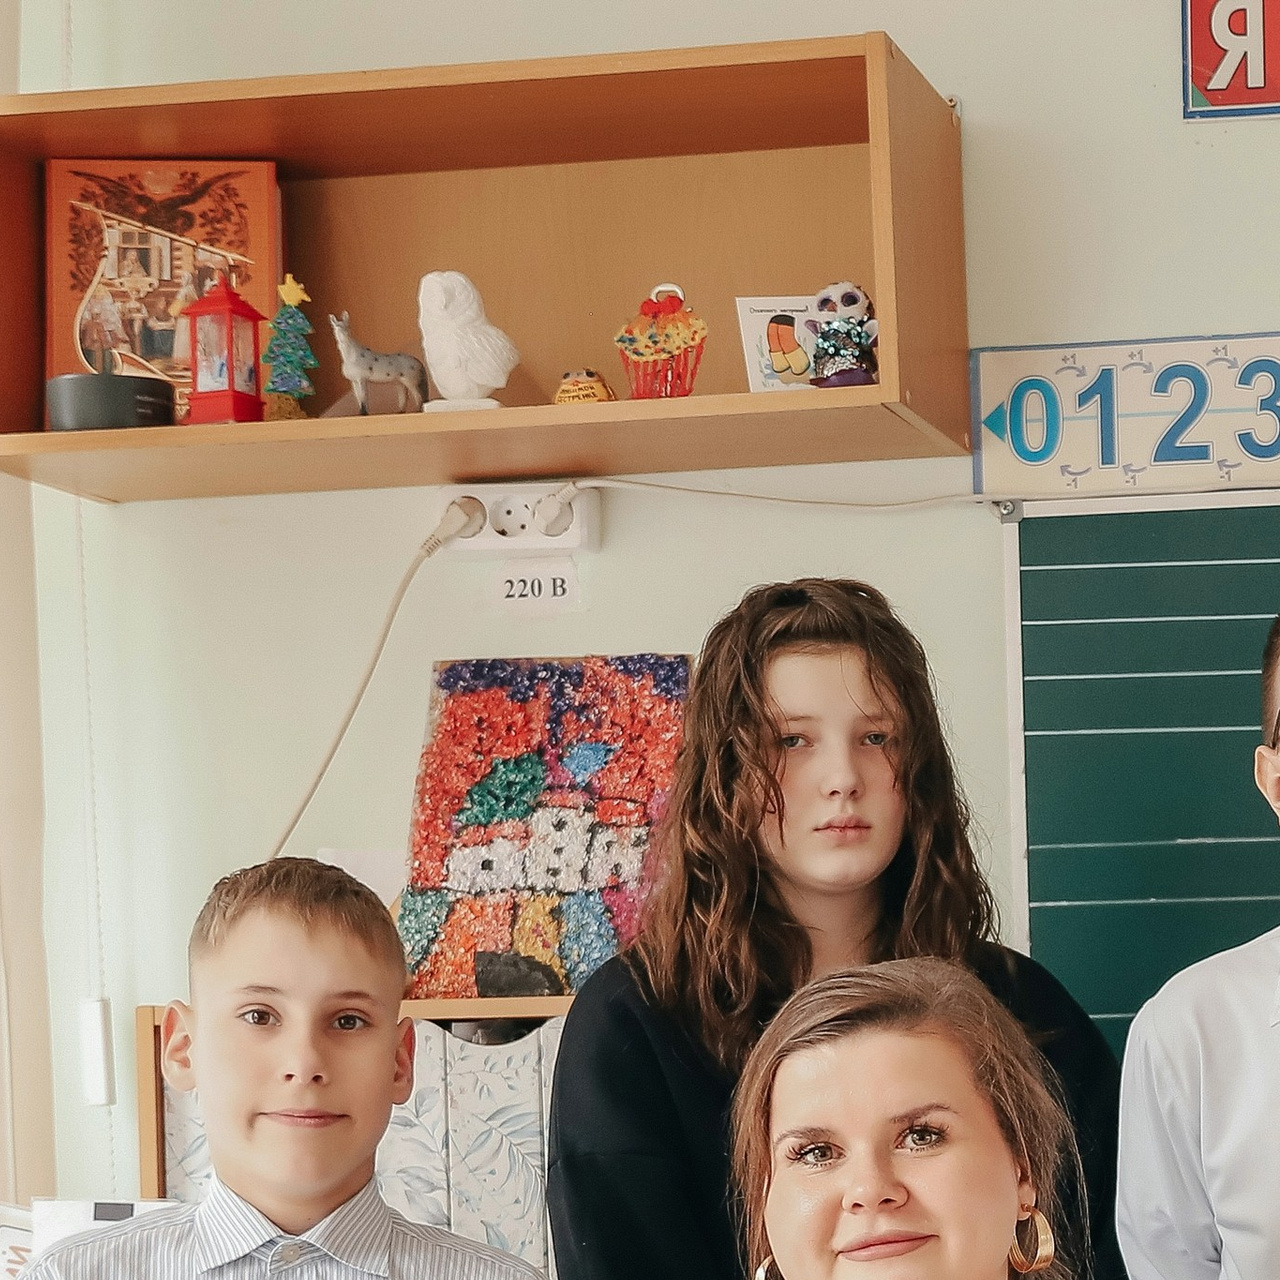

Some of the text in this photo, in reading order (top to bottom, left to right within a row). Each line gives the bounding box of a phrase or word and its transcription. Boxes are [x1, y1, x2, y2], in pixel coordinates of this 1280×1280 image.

[1206, 0, 1264, 90] Я
[1061, 353, 1077, 365] +1
[1129, 350, 1144, 362] +1
[1212, 345, 1229, 357] +1
[1009, 378, 1062, 462] 0
[1077, 367, 1116, 466] 1
[1153, 364, 1211, 462] 2
[1067, 477, 1078, 489] -1
[1125, 475, 1137, 486] -1
[1220, 470, 1232, 482] -1
[504, 576, 567, 599] 220 В
